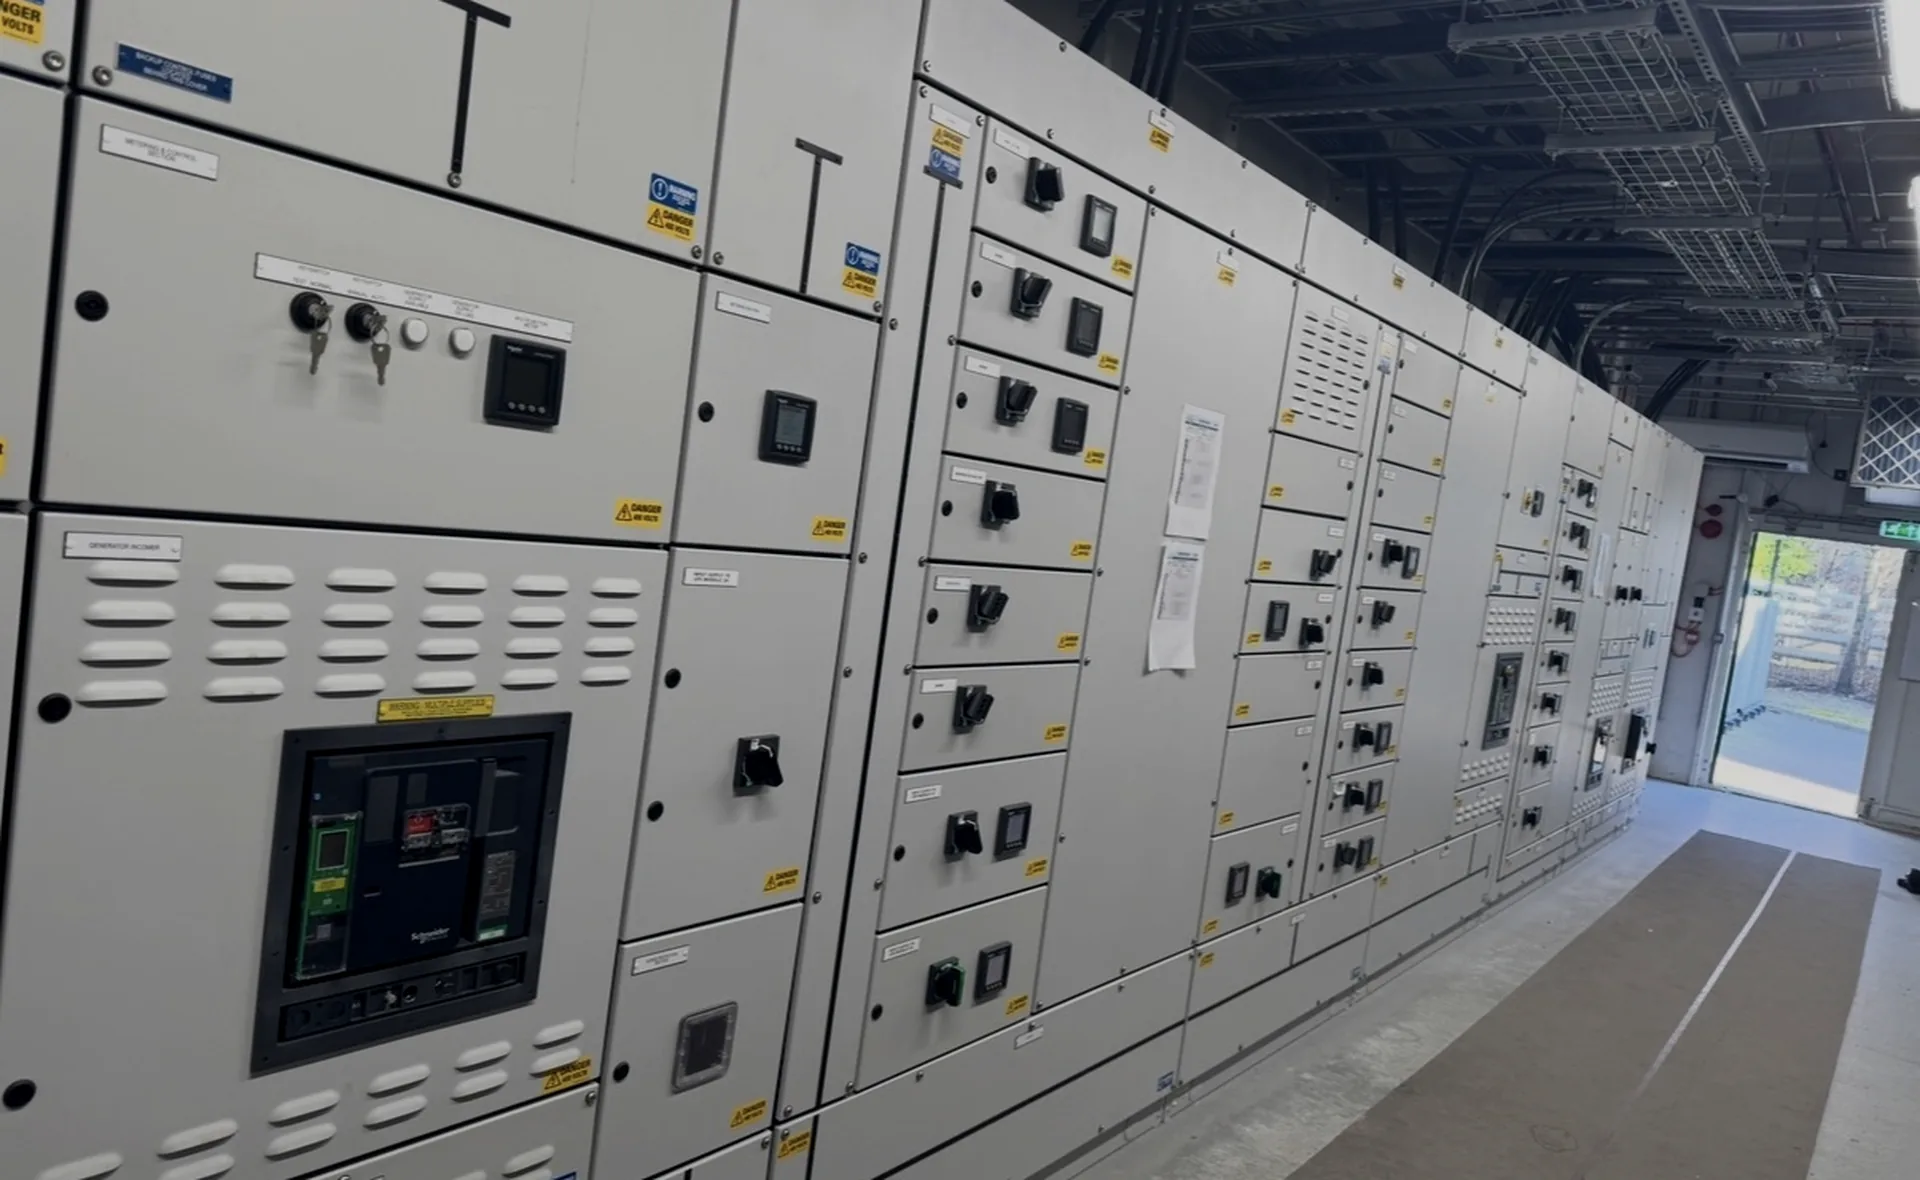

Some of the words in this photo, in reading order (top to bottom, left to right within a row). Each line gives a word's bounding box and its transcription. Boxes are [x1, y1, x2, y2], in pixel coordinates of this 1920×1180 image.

[0, 0, 41, 23] NGER
[1, 15, 35, 35] VOLTS
[663, 210, 694, 228] DANGER
[631, 503, 662, 513] DANGER
[824, 520, 846, 529] DANGER
[88, 541, 130, 551] GENERATOR
[776, 869, 799, 881] DANGER
[742, 1099, 766, 1115] DANGER
